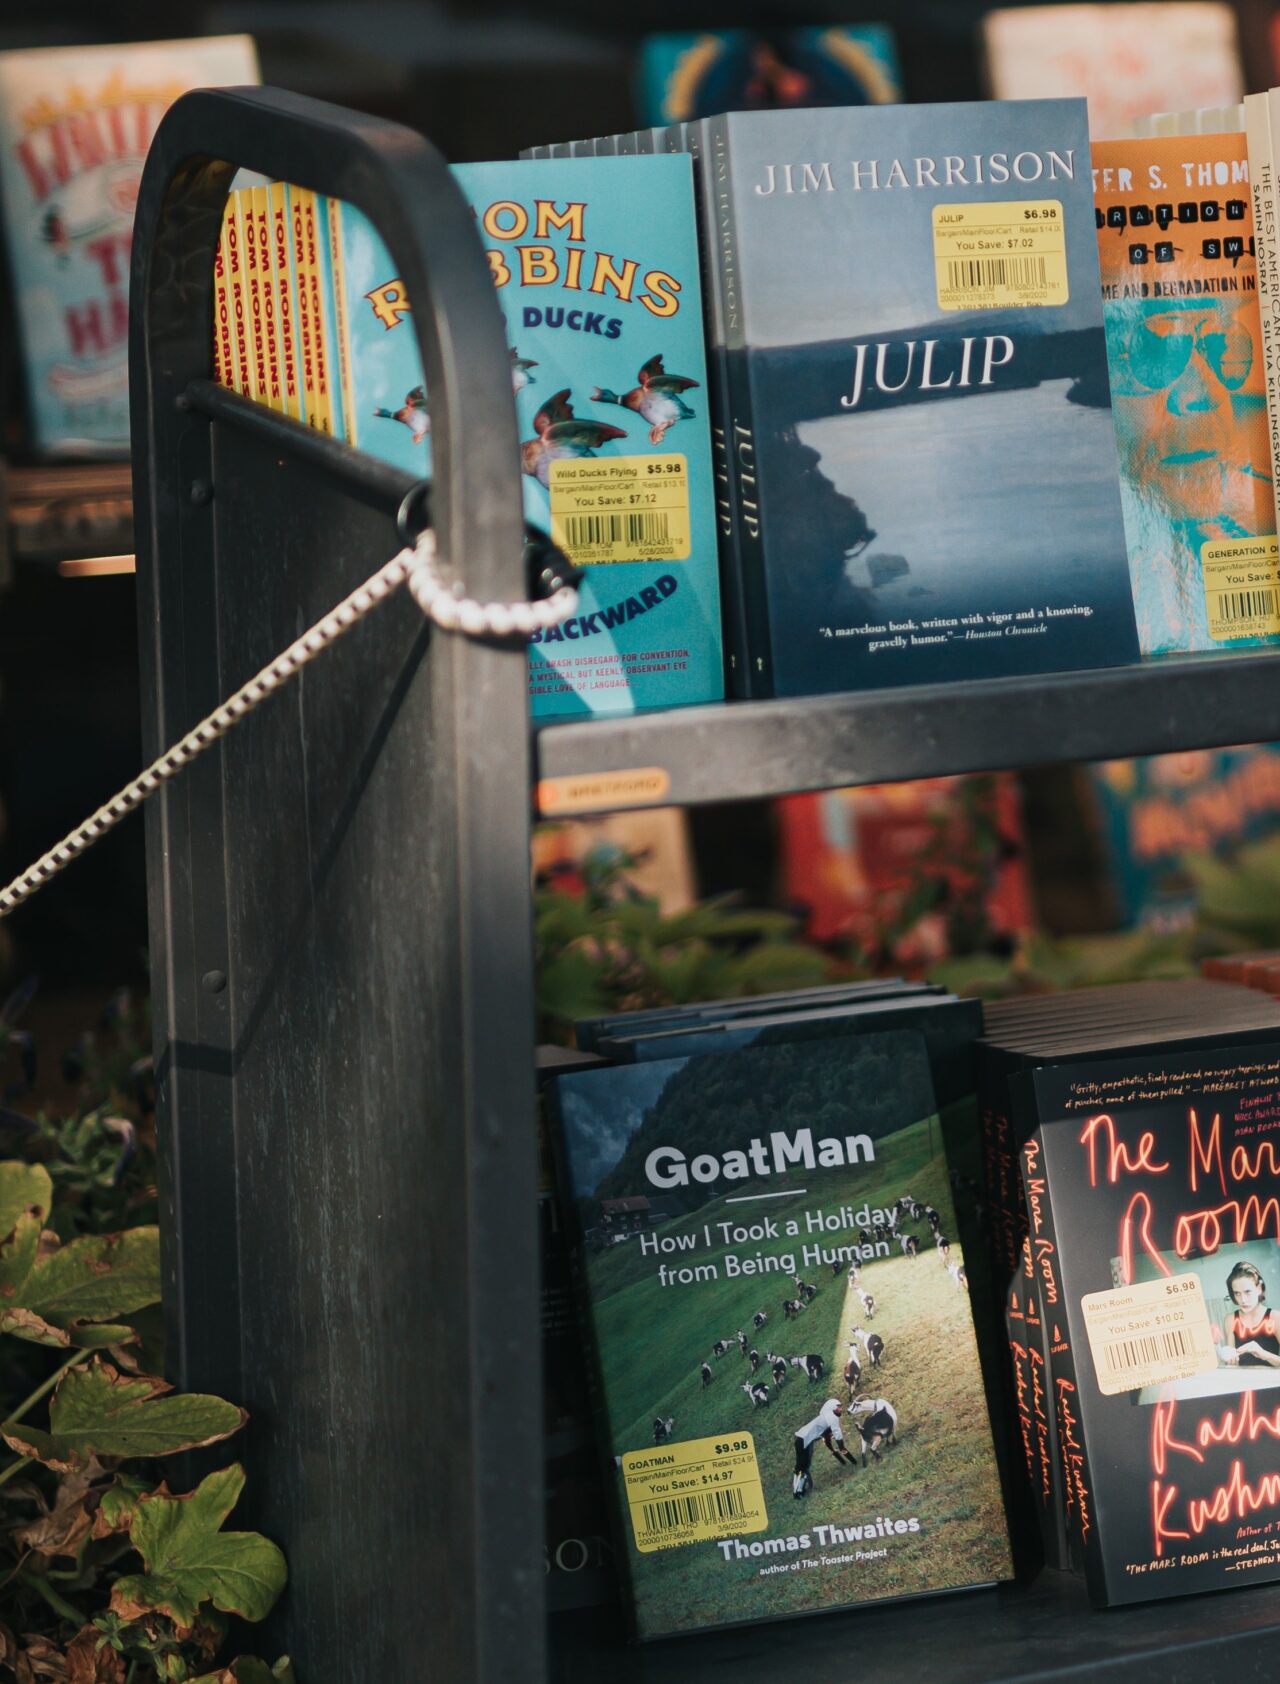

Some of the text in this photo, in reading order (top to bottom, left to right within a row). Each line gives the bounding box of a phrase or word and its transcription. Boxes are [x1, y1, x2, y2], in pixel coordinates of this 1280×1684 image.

[754, 150, 1076, 196] JIM HARRISON
[1148, 165, 1168, 189] S.
[483, 200, 587, 242] OM
[939, 209, 1057, 223] JULIP $6.98
[956, 239, 1034, 250] You $7.02
[364, 245, 683, 332] RBBINS
[1123, 276, 1239, 298] AND DEGRADATION
[246, 209, 267, 396] TOM ROBBINS
[275, 208, 296, 397] TOM ROBBINS
[522, 305, 624, 340] DUCKS
[839, 334, 1015, 407] JULIP
[556, 463, 682, 479] Wild Ducks Flying $5.98
[574, 494, 657, 506] You $7.12
[1208, 547, 1266, 559] GENERATION
[1226, 575, 1245, 584] You
[835, 605, 1094, 637] marvelous book, written with vigor and knowing,
[868, 624, 1048, 652] gravelly Chronicle
[575, 653, 638, 666] DISREGARD FOR
[626, 661, 688, 674] OBSERVANT EYE
[644, 1127, 875, 1188] GoatMan
[1080, 1114, 1170, 1187] The
[640, 1204, 899, 1256] How I Took a Holiday
[1024, 1139, 1058, 1304] The Mars Room
[658, 1240, 890, 1287] from Being Human
[1109, 1281, 1196, 1307] Room $6.98
[1108, 1311, 1185, 1335] You $10.02
[628, 1440, 748, 1471] GOATMAN $9.98
[627, 1464, 705, 1484] Bargain/MainFloor/Cart
[649, 1471, 733, 1494] You Save: $14.97
[717, 1534, 811, 1561] Thomas
[812, 1517, 920, 1546] Thwaites
[1236, 1527, 1261, 1541] Author
[759, 1548, 888, 1575] author The Toaster Project
[1149, 1557, 1176, 1571] MARS
[1180, 1552, 1209, 1566] ROOM
[1220, 1547, 1233, 1558] the
[1250, 1541, 1270, 1553] deal.
